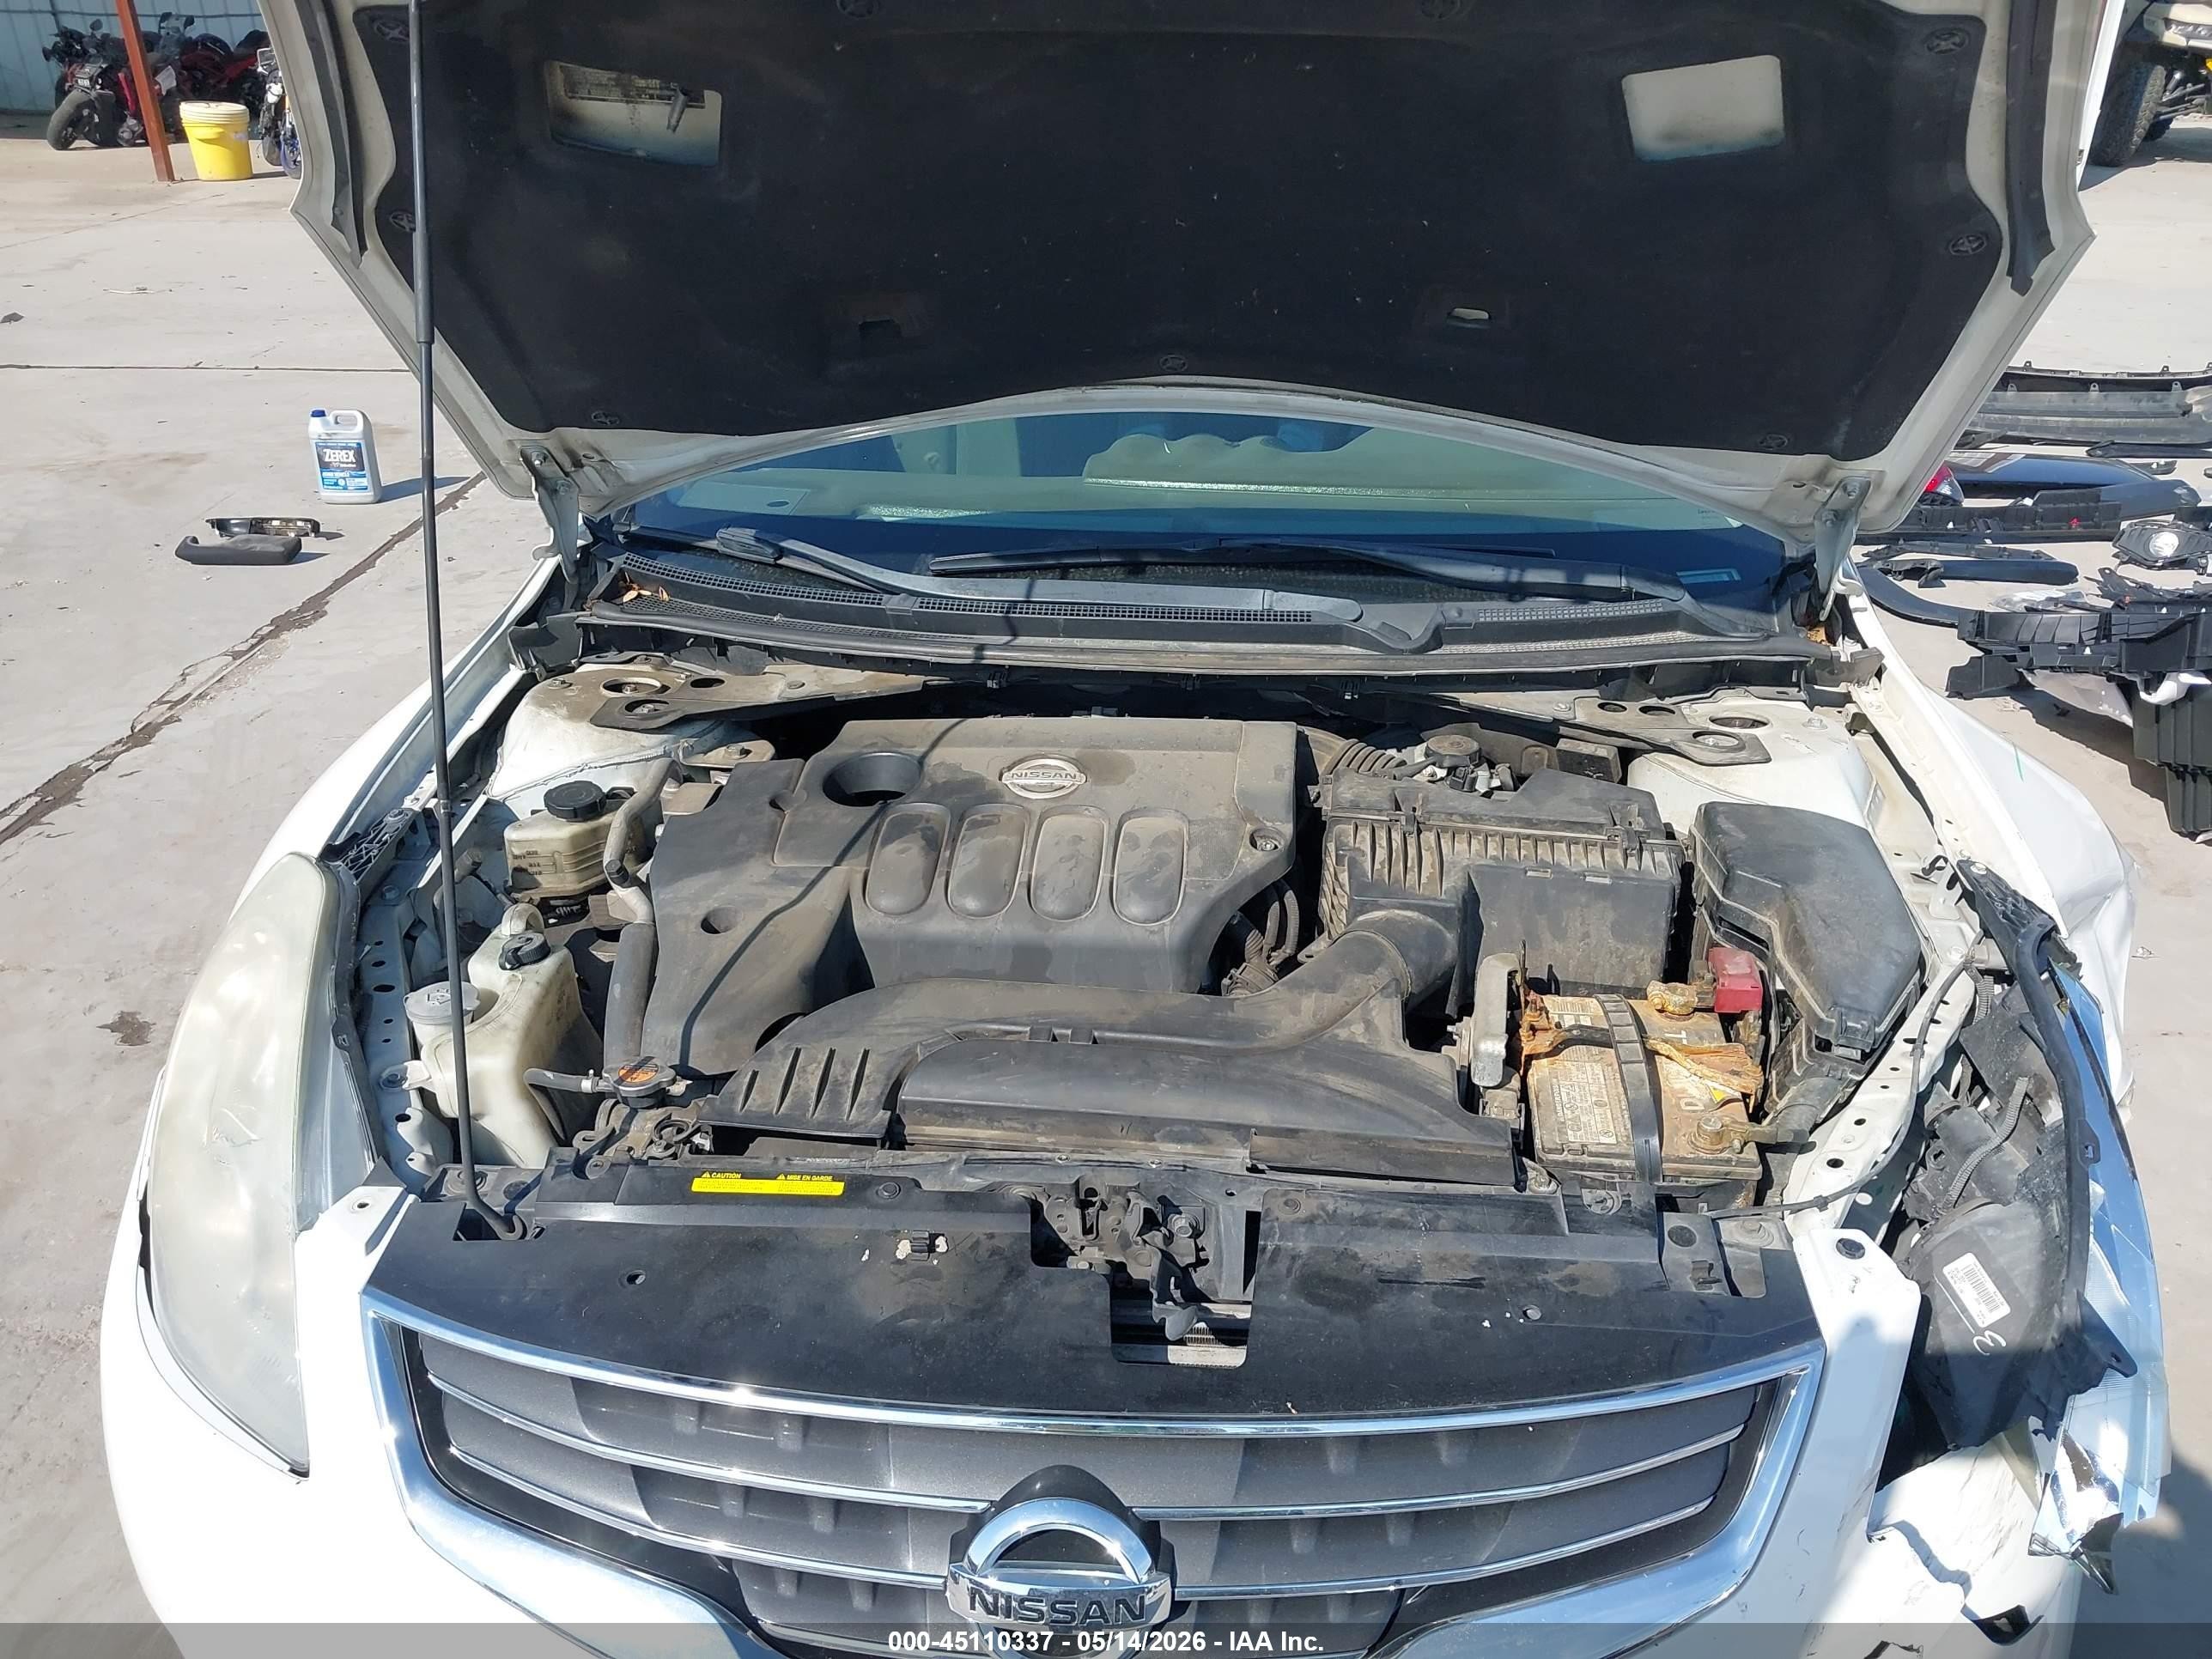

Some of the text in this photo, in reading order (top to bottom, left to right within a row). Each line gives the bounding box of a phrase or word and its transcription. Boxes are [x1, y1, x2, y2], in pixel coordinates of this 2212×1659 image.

[323, 449, 356, 462] ZEREX
[1011, 771, 1077, 780] NISSAN
[969, 1586, 1146, 1626] NISSAN
